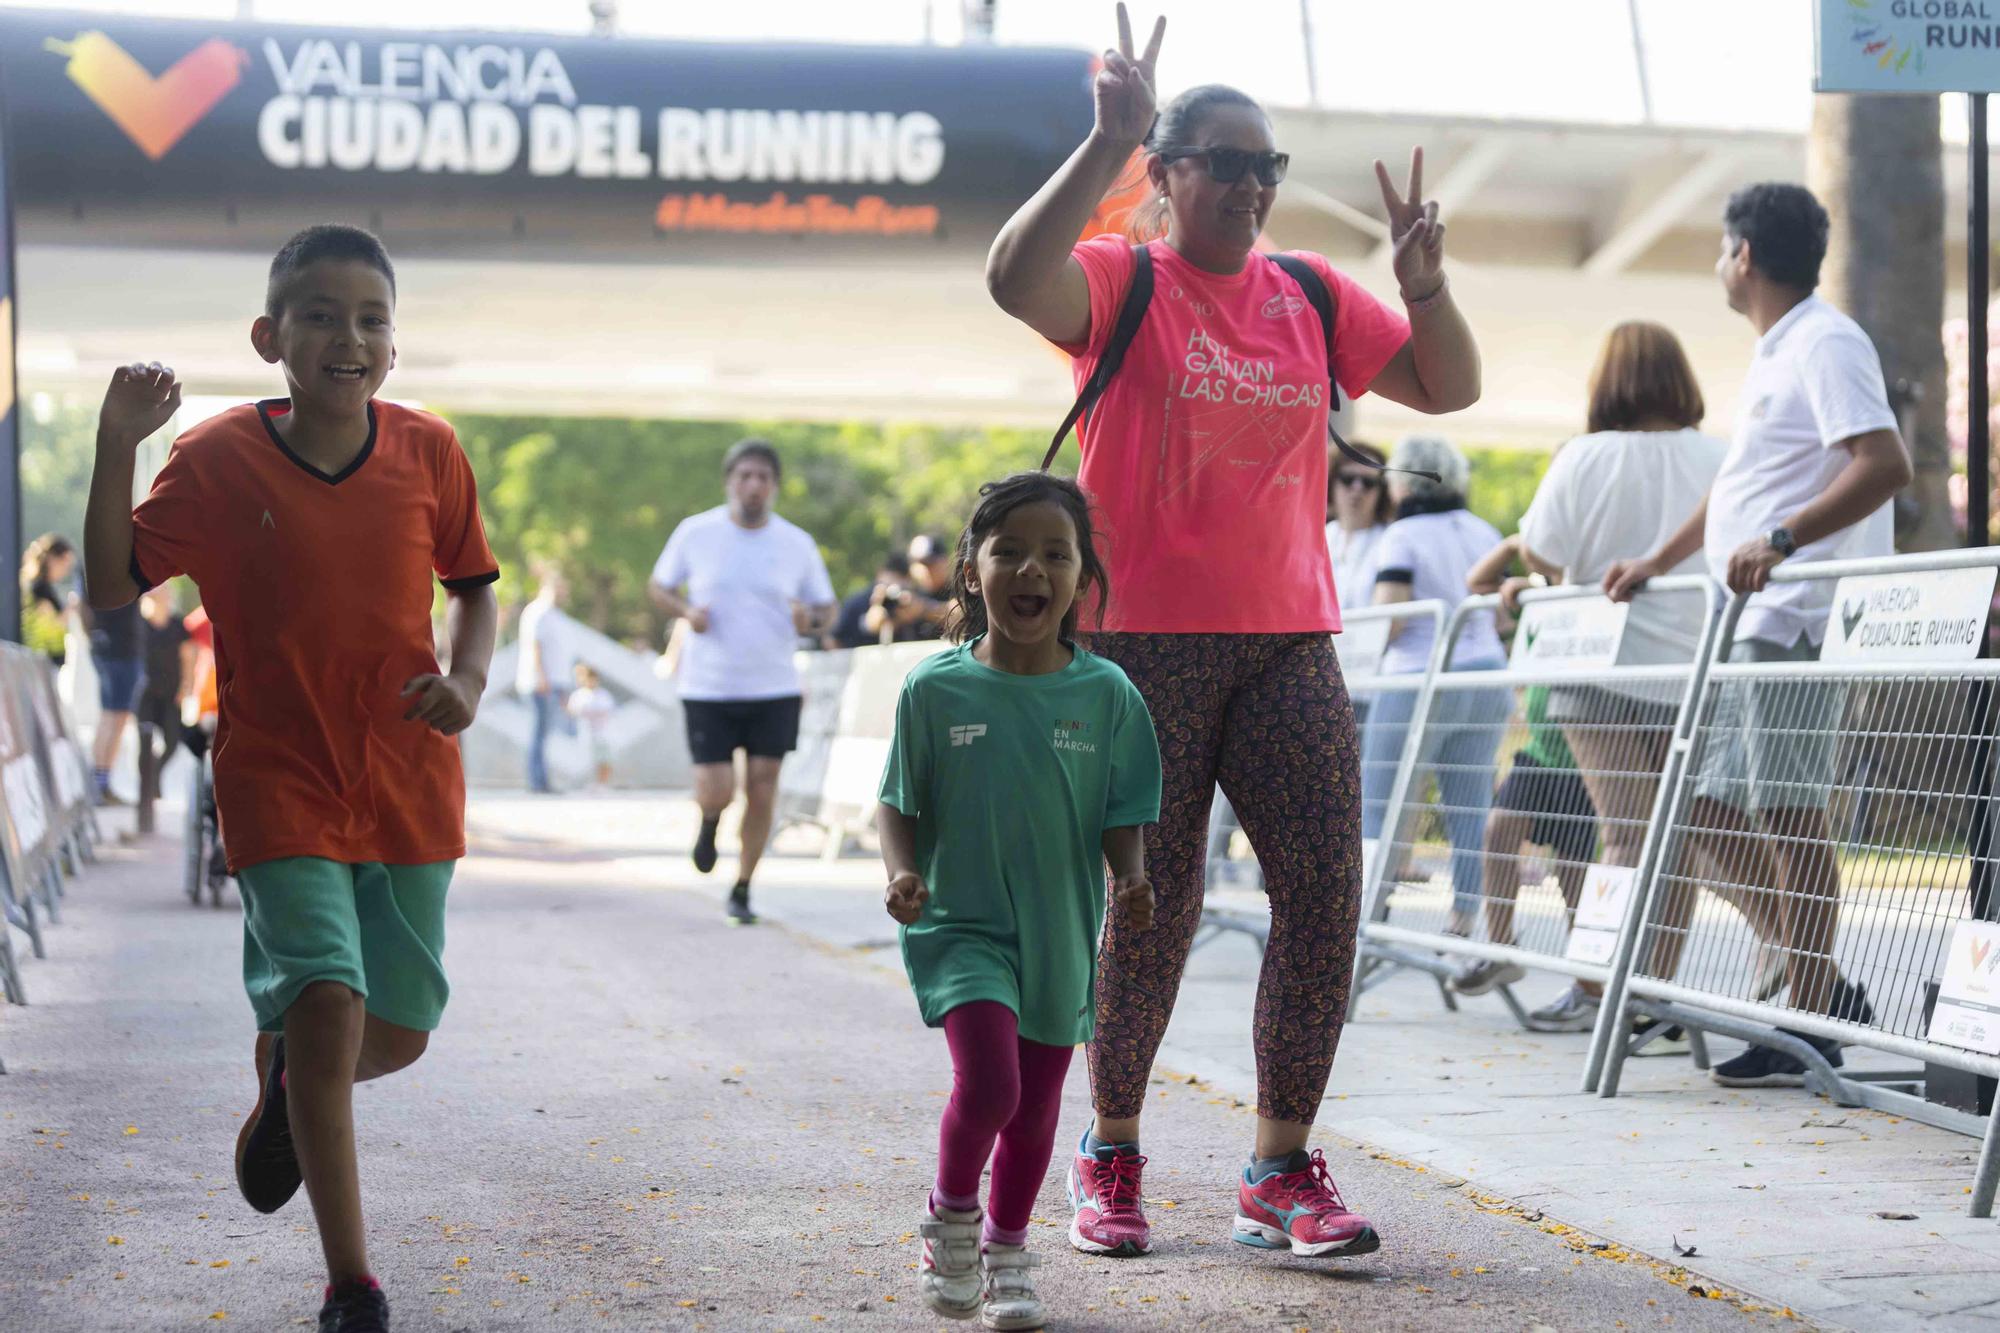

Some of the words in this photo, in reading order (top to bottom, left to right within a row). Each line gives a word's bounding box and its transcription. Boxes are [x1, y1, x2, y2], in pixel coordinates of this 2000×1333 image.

[1891, 0, 1991, 19] GLOBAL
[1926, 24, 2000, 48] RUN
[263, 37, 577, 107] VALENCIA
[258, 94, 522, 175] CIUDAD
[528, 103, 650, 180] DEL
[658, 106, 945, 185] RUNNING
[1187, 328, 1229, 358] HOY
[1185, 352, 1274, 383] GANAN
[1179, 374, 1227, 401] LAS
[1232, 382, 1323, 407] CHICAS
[1869, 586, 1920, 613] VALENCIA
[1859, 620, 1901, 648] CIUDAD
[1901, 620, 1922, 647] DEL
[1053, 728, 1069, 740] EN
[1053, 738, 1096, 754] MARCHA
